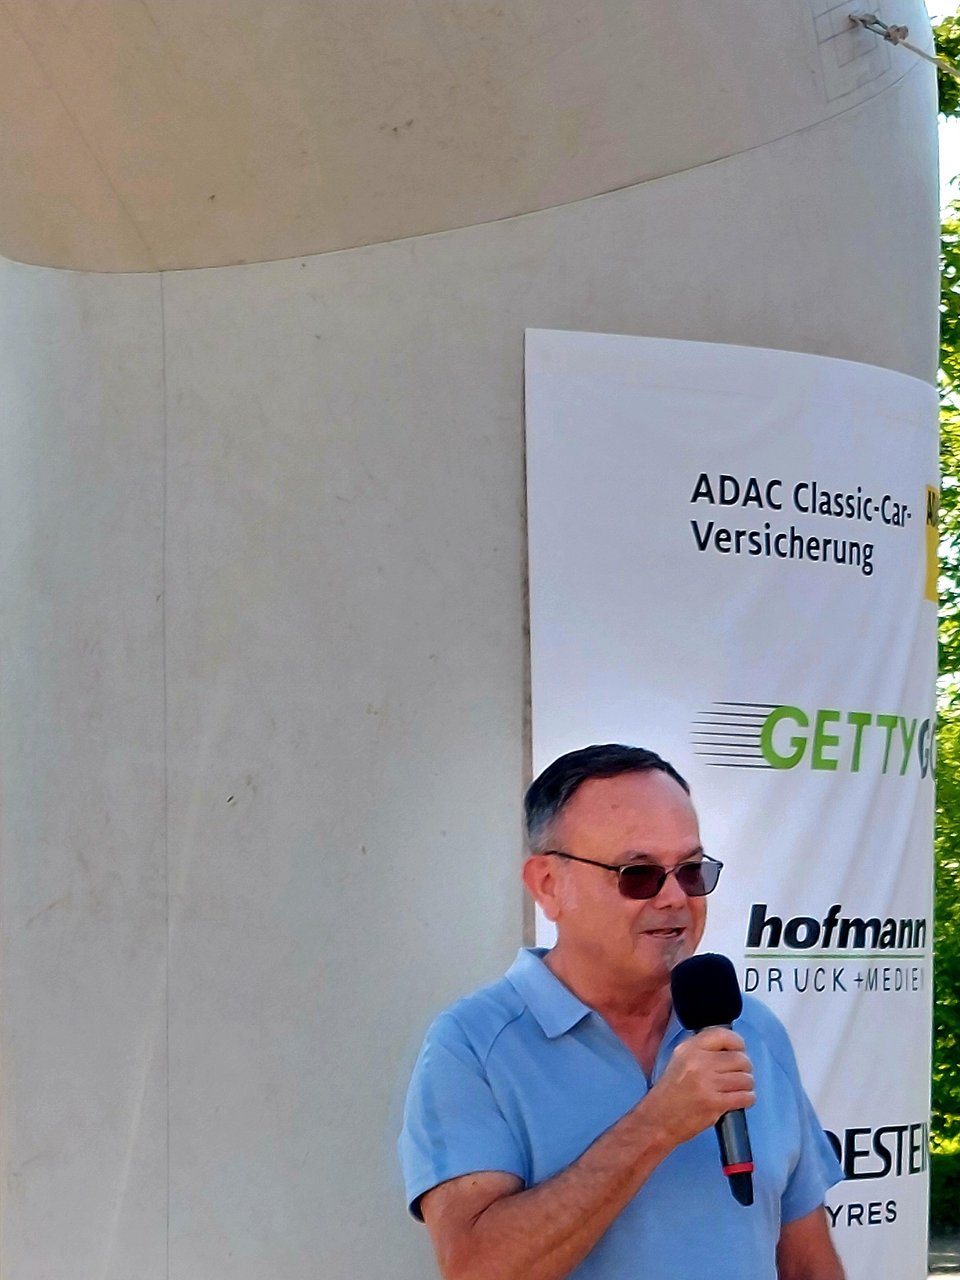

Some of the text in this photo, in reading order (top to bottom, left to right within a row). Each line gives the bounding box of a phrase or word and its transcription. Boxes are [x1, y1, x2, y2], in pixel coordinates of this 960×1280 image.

[690, 473, 912, 528] ADAC Classic-Car-
[690, 519, 875, 576] Versicherung
[745, 903, 926, 950] hofmann
[825, 1200, 897, 1228] YRES
